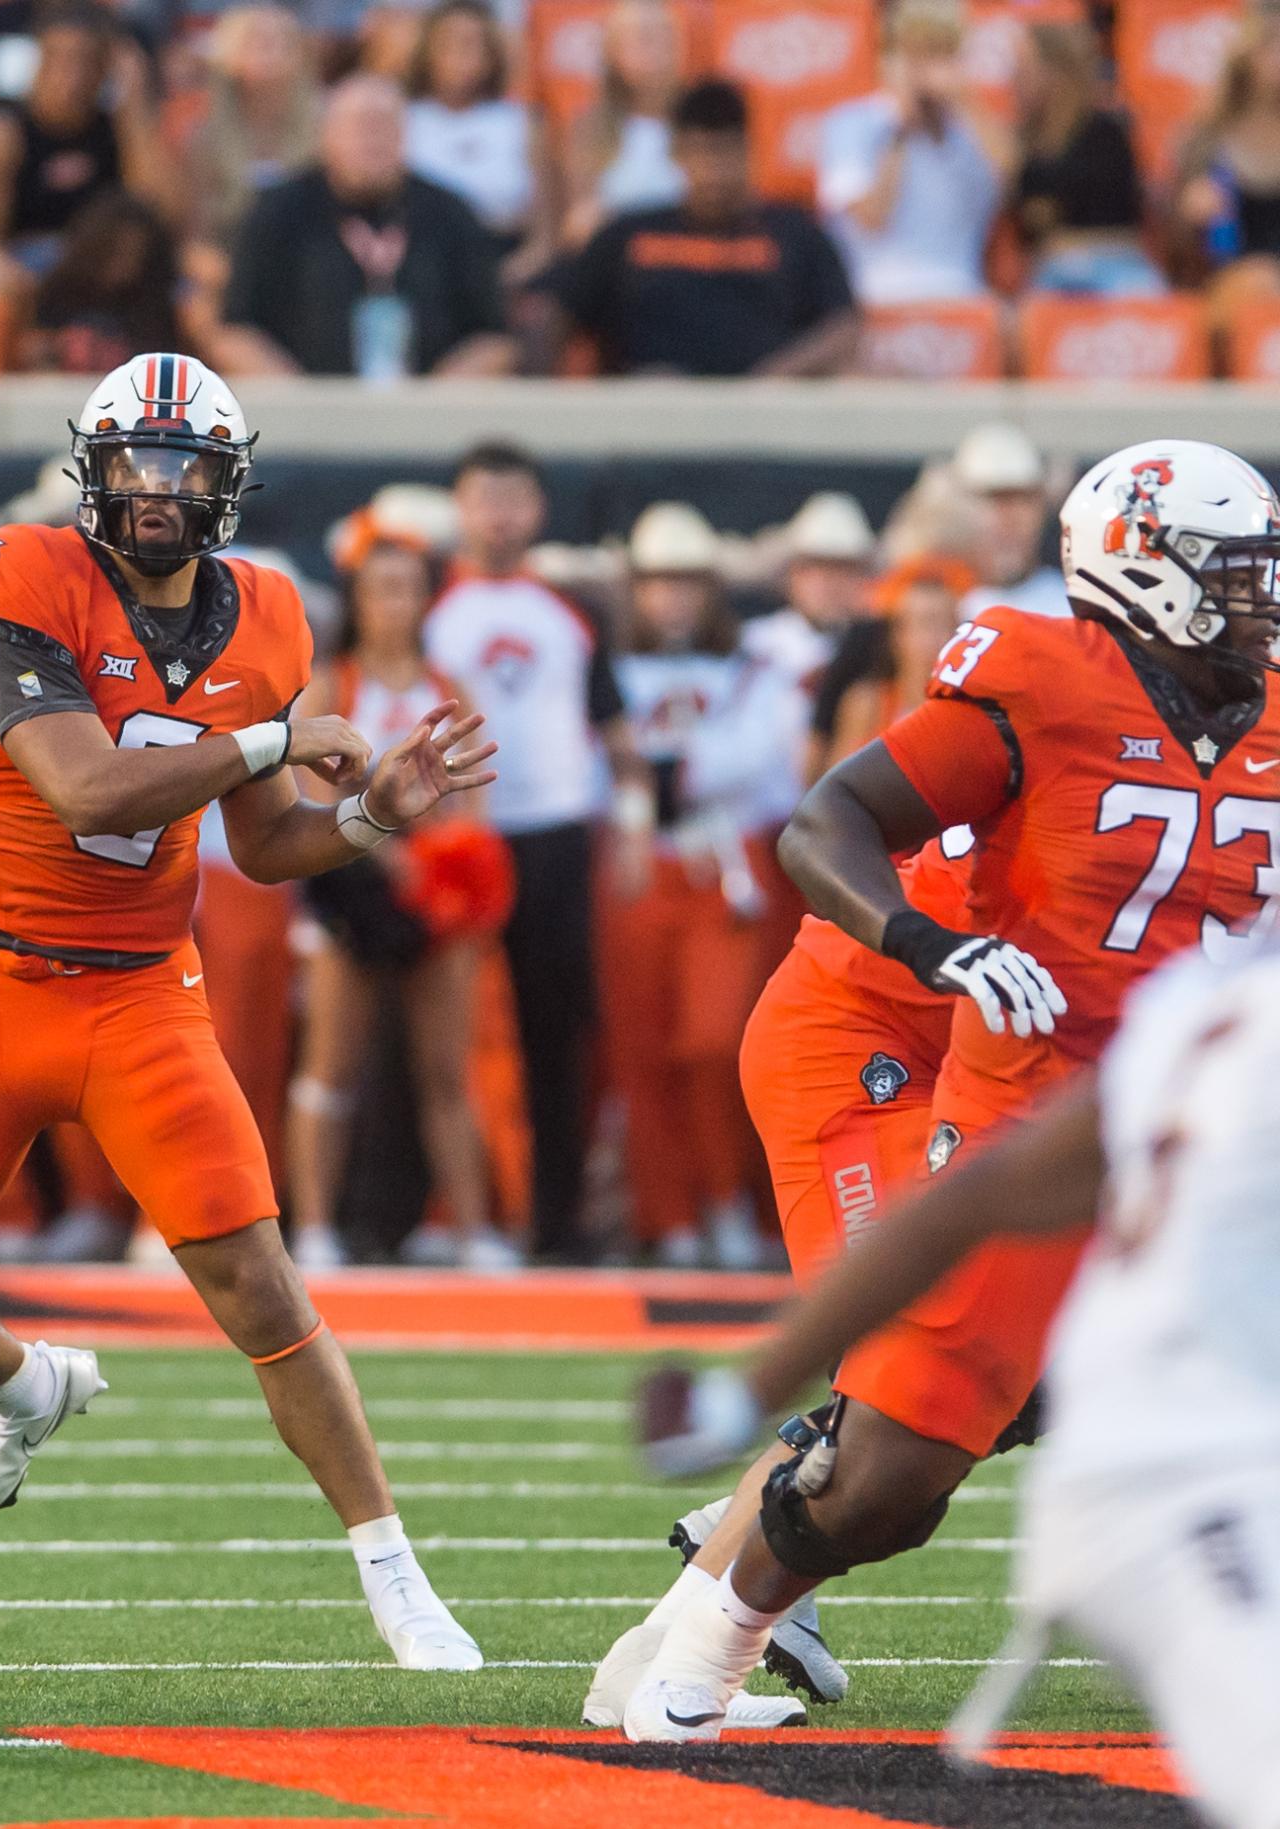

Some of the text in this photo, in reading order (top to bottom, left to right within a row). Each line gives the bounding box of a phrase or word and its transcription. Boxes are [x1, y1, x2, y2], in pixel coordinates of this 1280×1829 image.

[97, 652, 140, 682] XII
[1119, 734, 1163, 761] XII
[834, 1162, 880, 1249] COW
